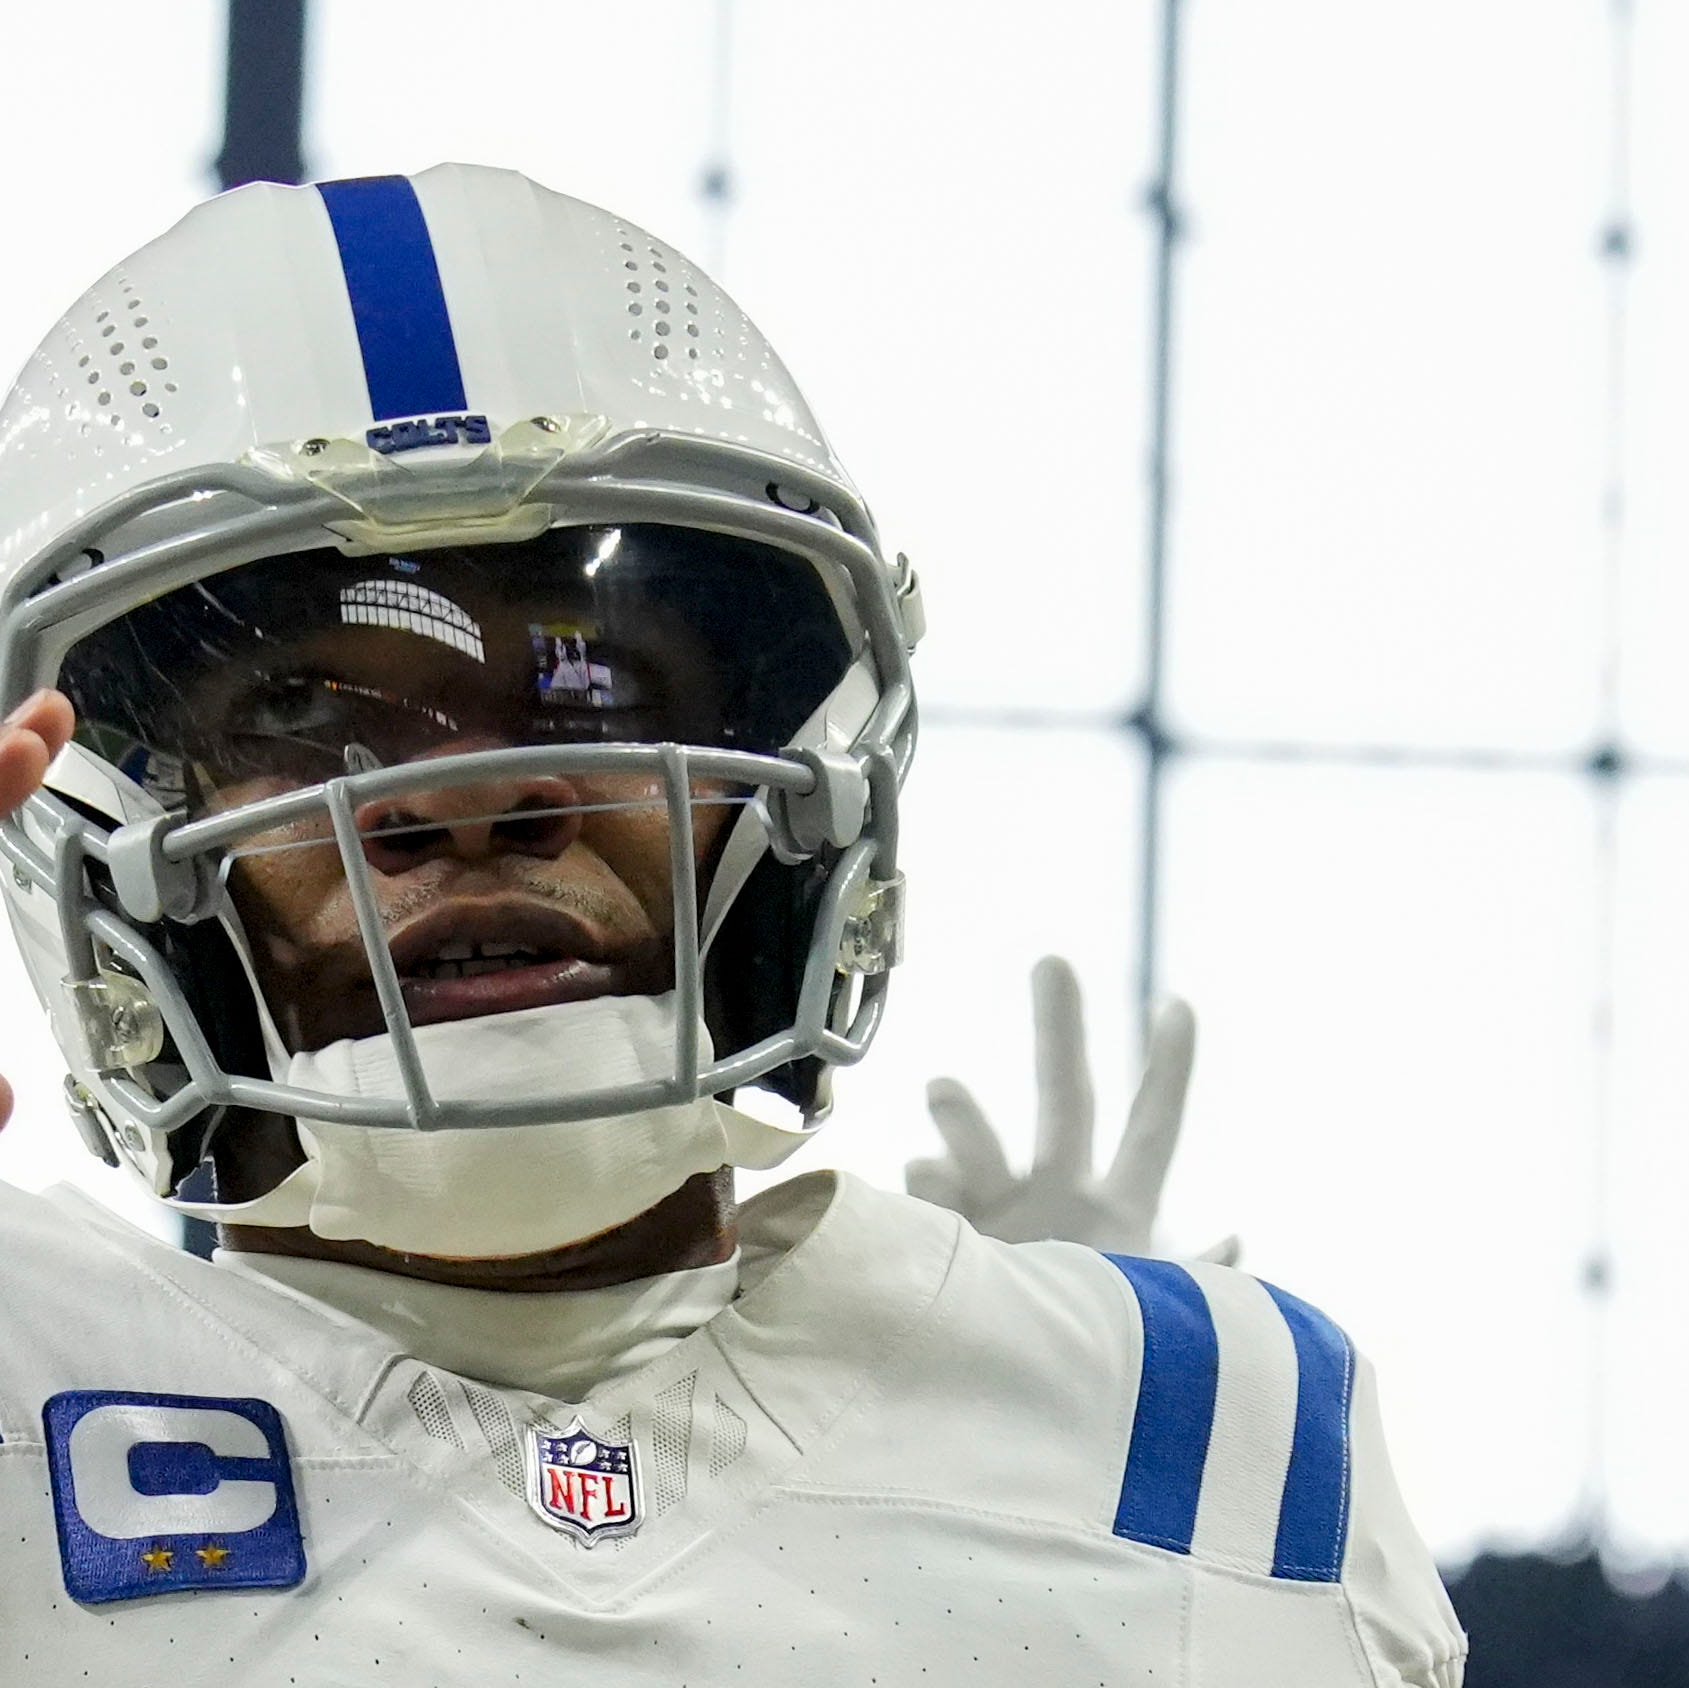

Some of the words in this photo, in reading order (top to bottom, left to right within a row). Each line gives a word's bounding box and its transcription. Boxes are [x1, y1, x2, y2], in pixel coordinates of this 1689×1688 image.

[366, 415, 492, 454] COLTS
[68, 1404, 278, 1540] C
[546, 1466, 628, 1522] NFL
